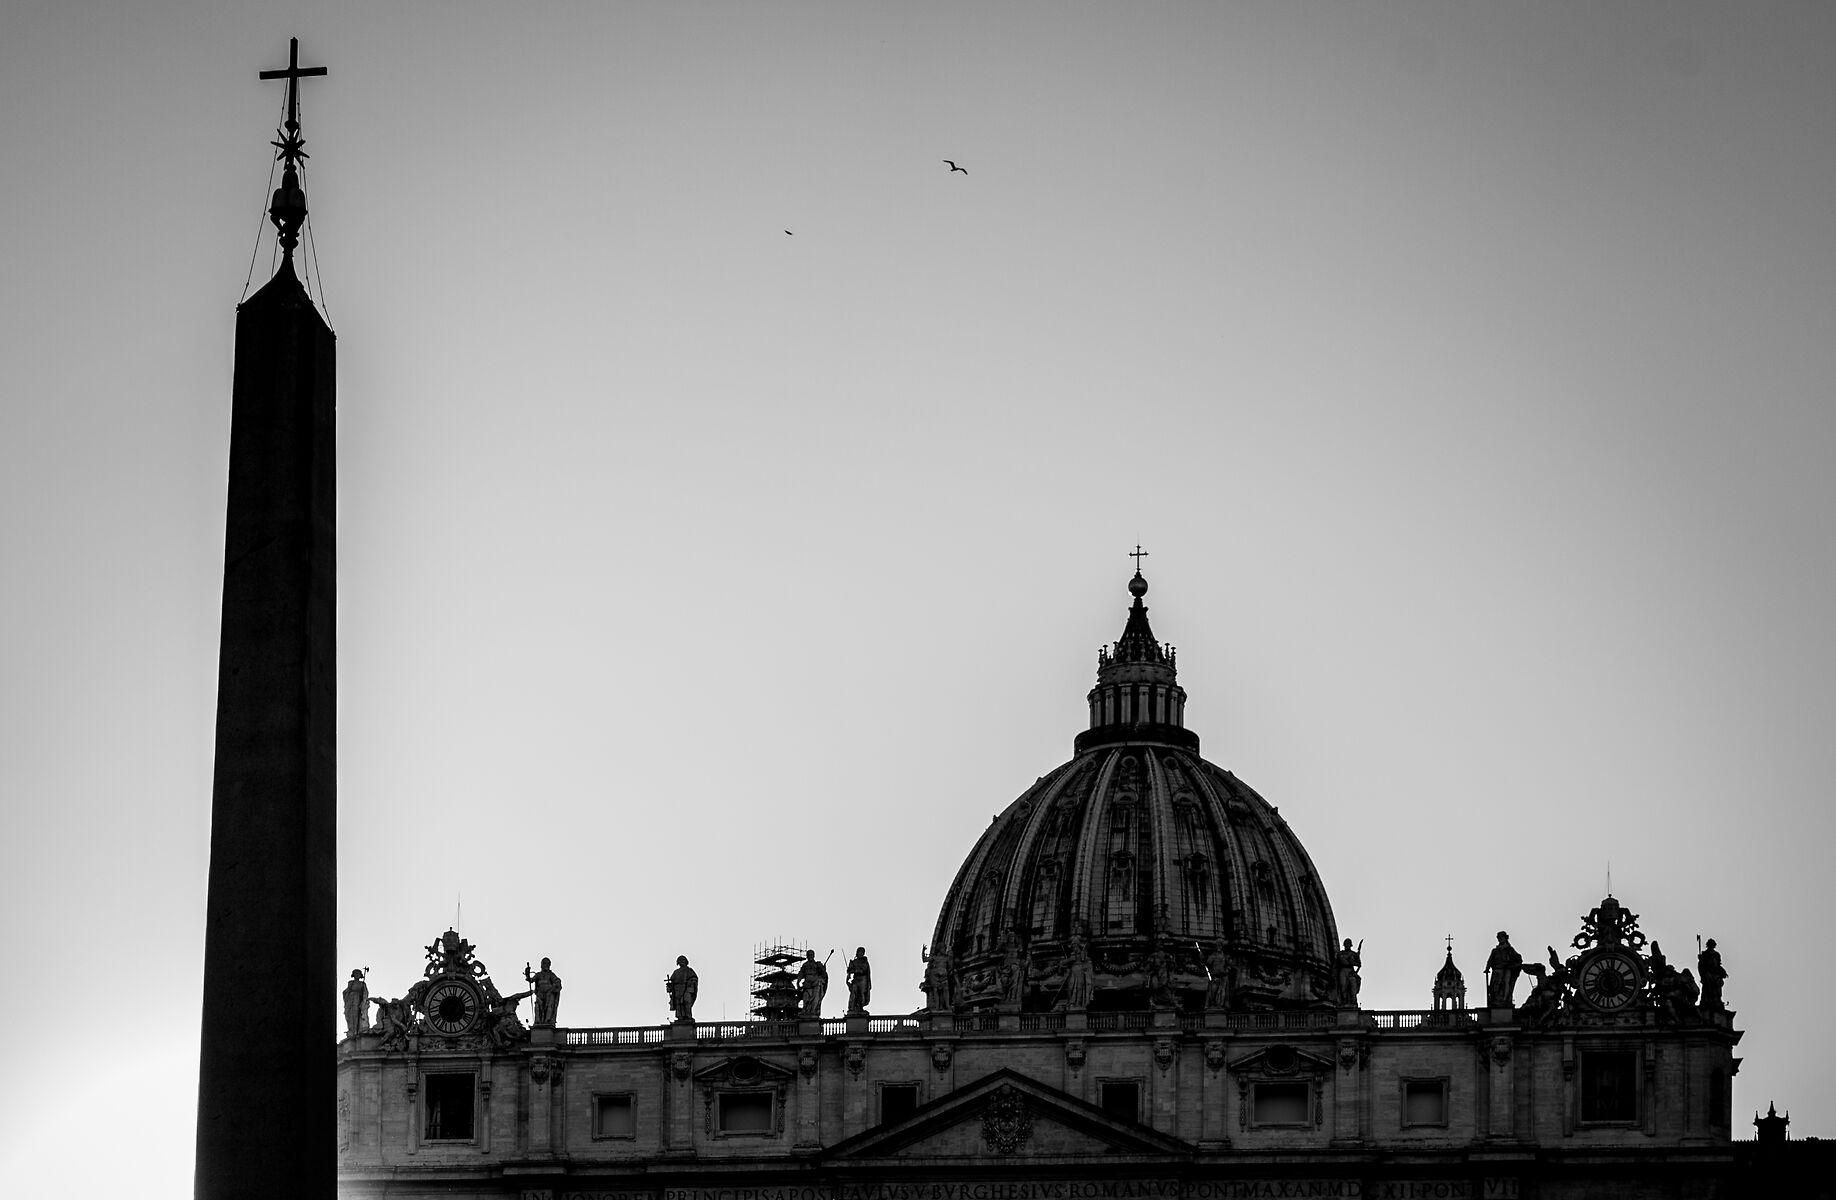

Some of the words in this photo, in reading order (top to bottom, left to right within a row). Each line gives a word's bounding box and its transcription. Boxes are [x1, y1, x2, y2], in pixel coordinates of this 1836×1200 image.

[840, 1185, 909, 1200] PAVLVS
[932, 1183, 1062, 1200] BVRGHESIVS
[1069, 1181, 1179, 1198] ROMANVS
[1185, 1182, 1240, 1198] PONT
[1243, 1181, 1289, 1198] MAX
[1486, 1179, 1516, 1195] VII
